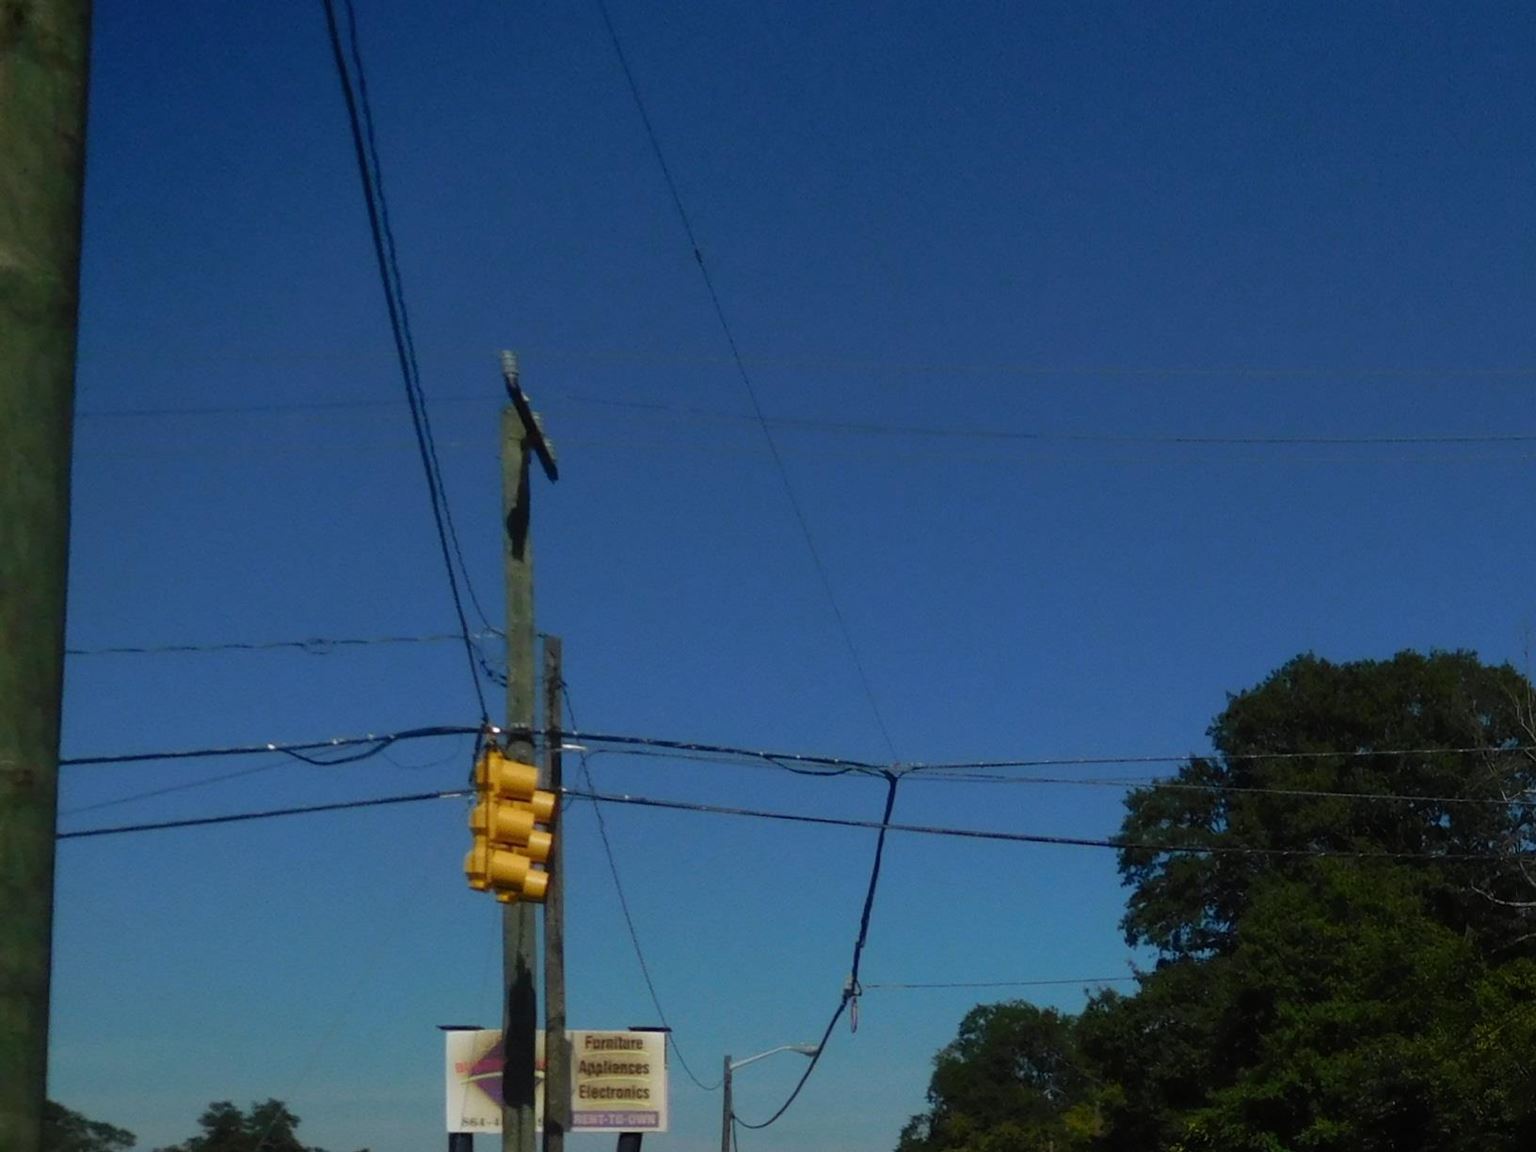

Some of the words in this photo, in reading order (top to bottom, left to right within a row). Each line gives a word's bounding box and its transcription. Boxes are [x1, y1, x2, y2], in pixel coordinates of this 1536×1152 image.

[584, 1035, 644, 1050] Furniture
[578, 1060, 650, 1077] Appliances
[578, 1084, 650, 1099] Electronics
